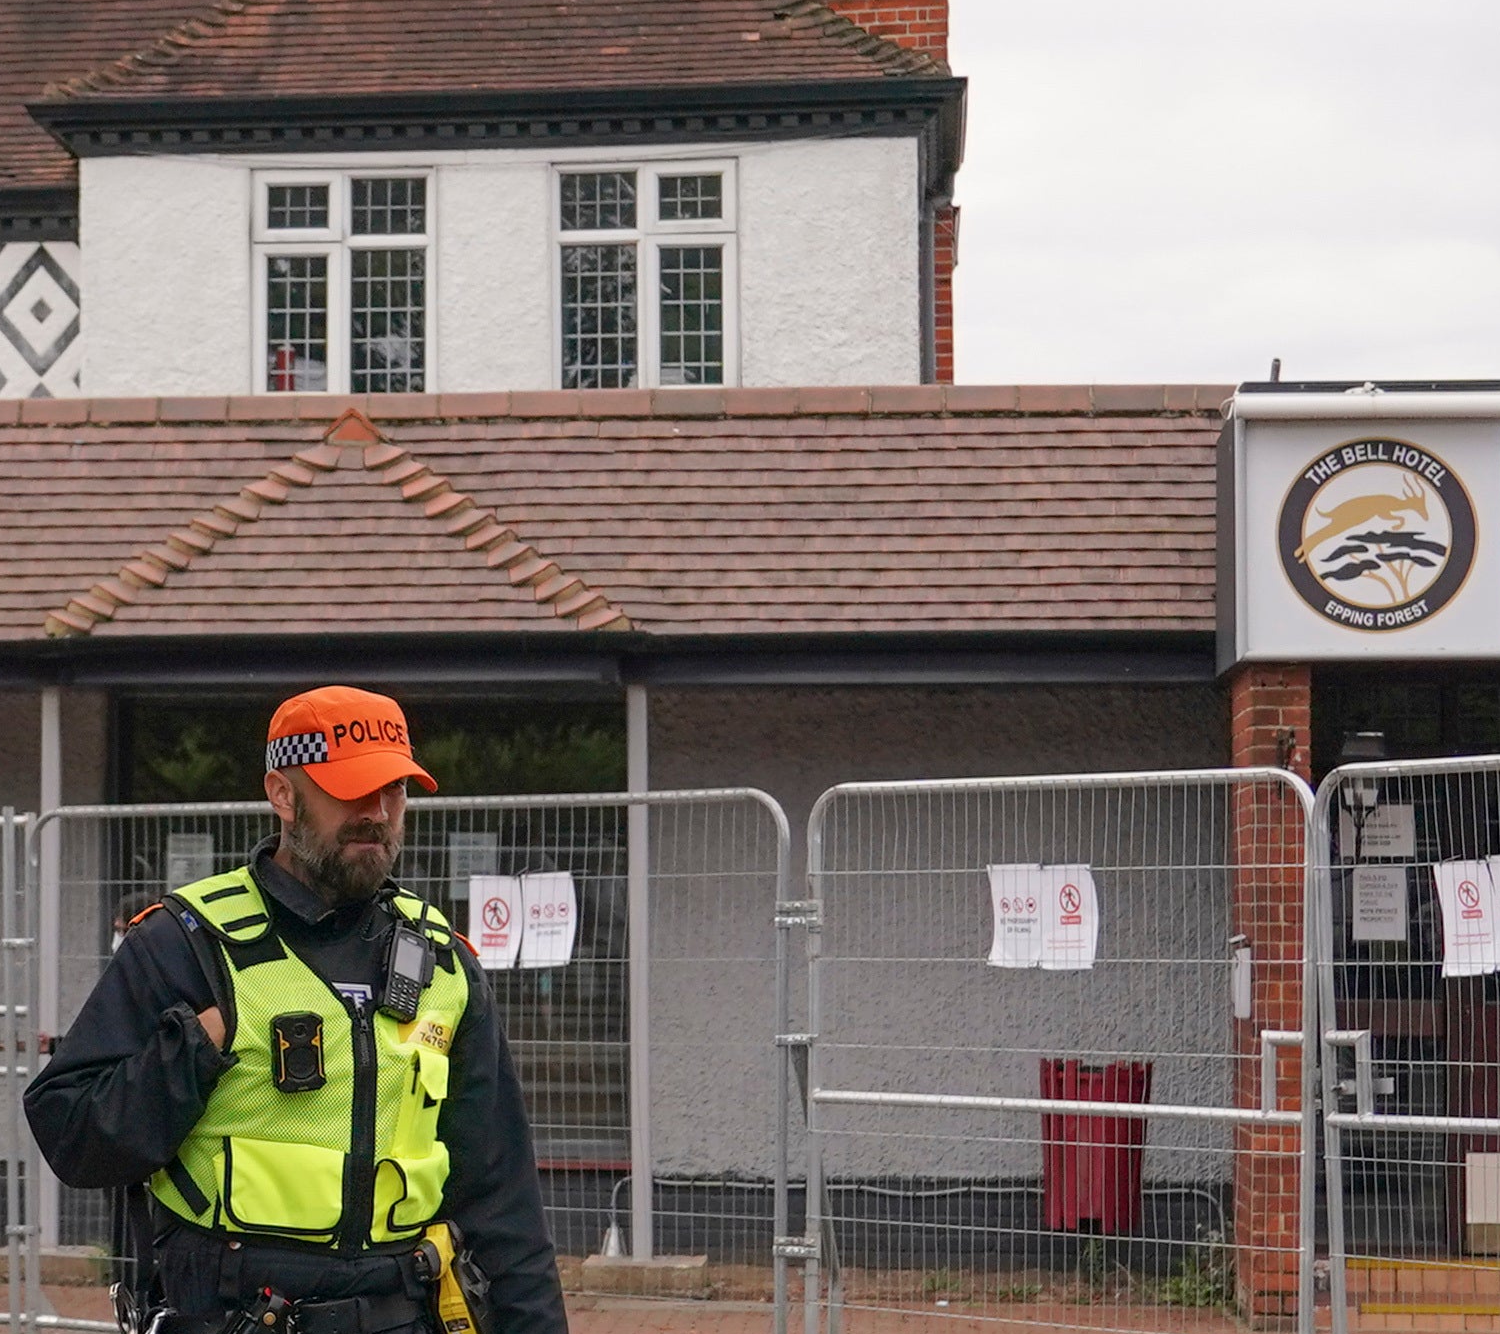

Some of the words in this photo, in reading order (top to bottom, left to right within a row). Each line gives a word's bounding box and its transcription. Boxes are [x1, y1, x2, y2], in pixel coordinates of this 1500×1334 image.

[1304, 454, 1342, 485] THE
[1341, 443, 1389, 465] BELL
[1392, 446, 1449, 487] HOTEL
[1324, 600, 1374, 627] EPPING
[1377, 599, 1430, 627] FOREST
[332, 719, 406, 748] POLICE
